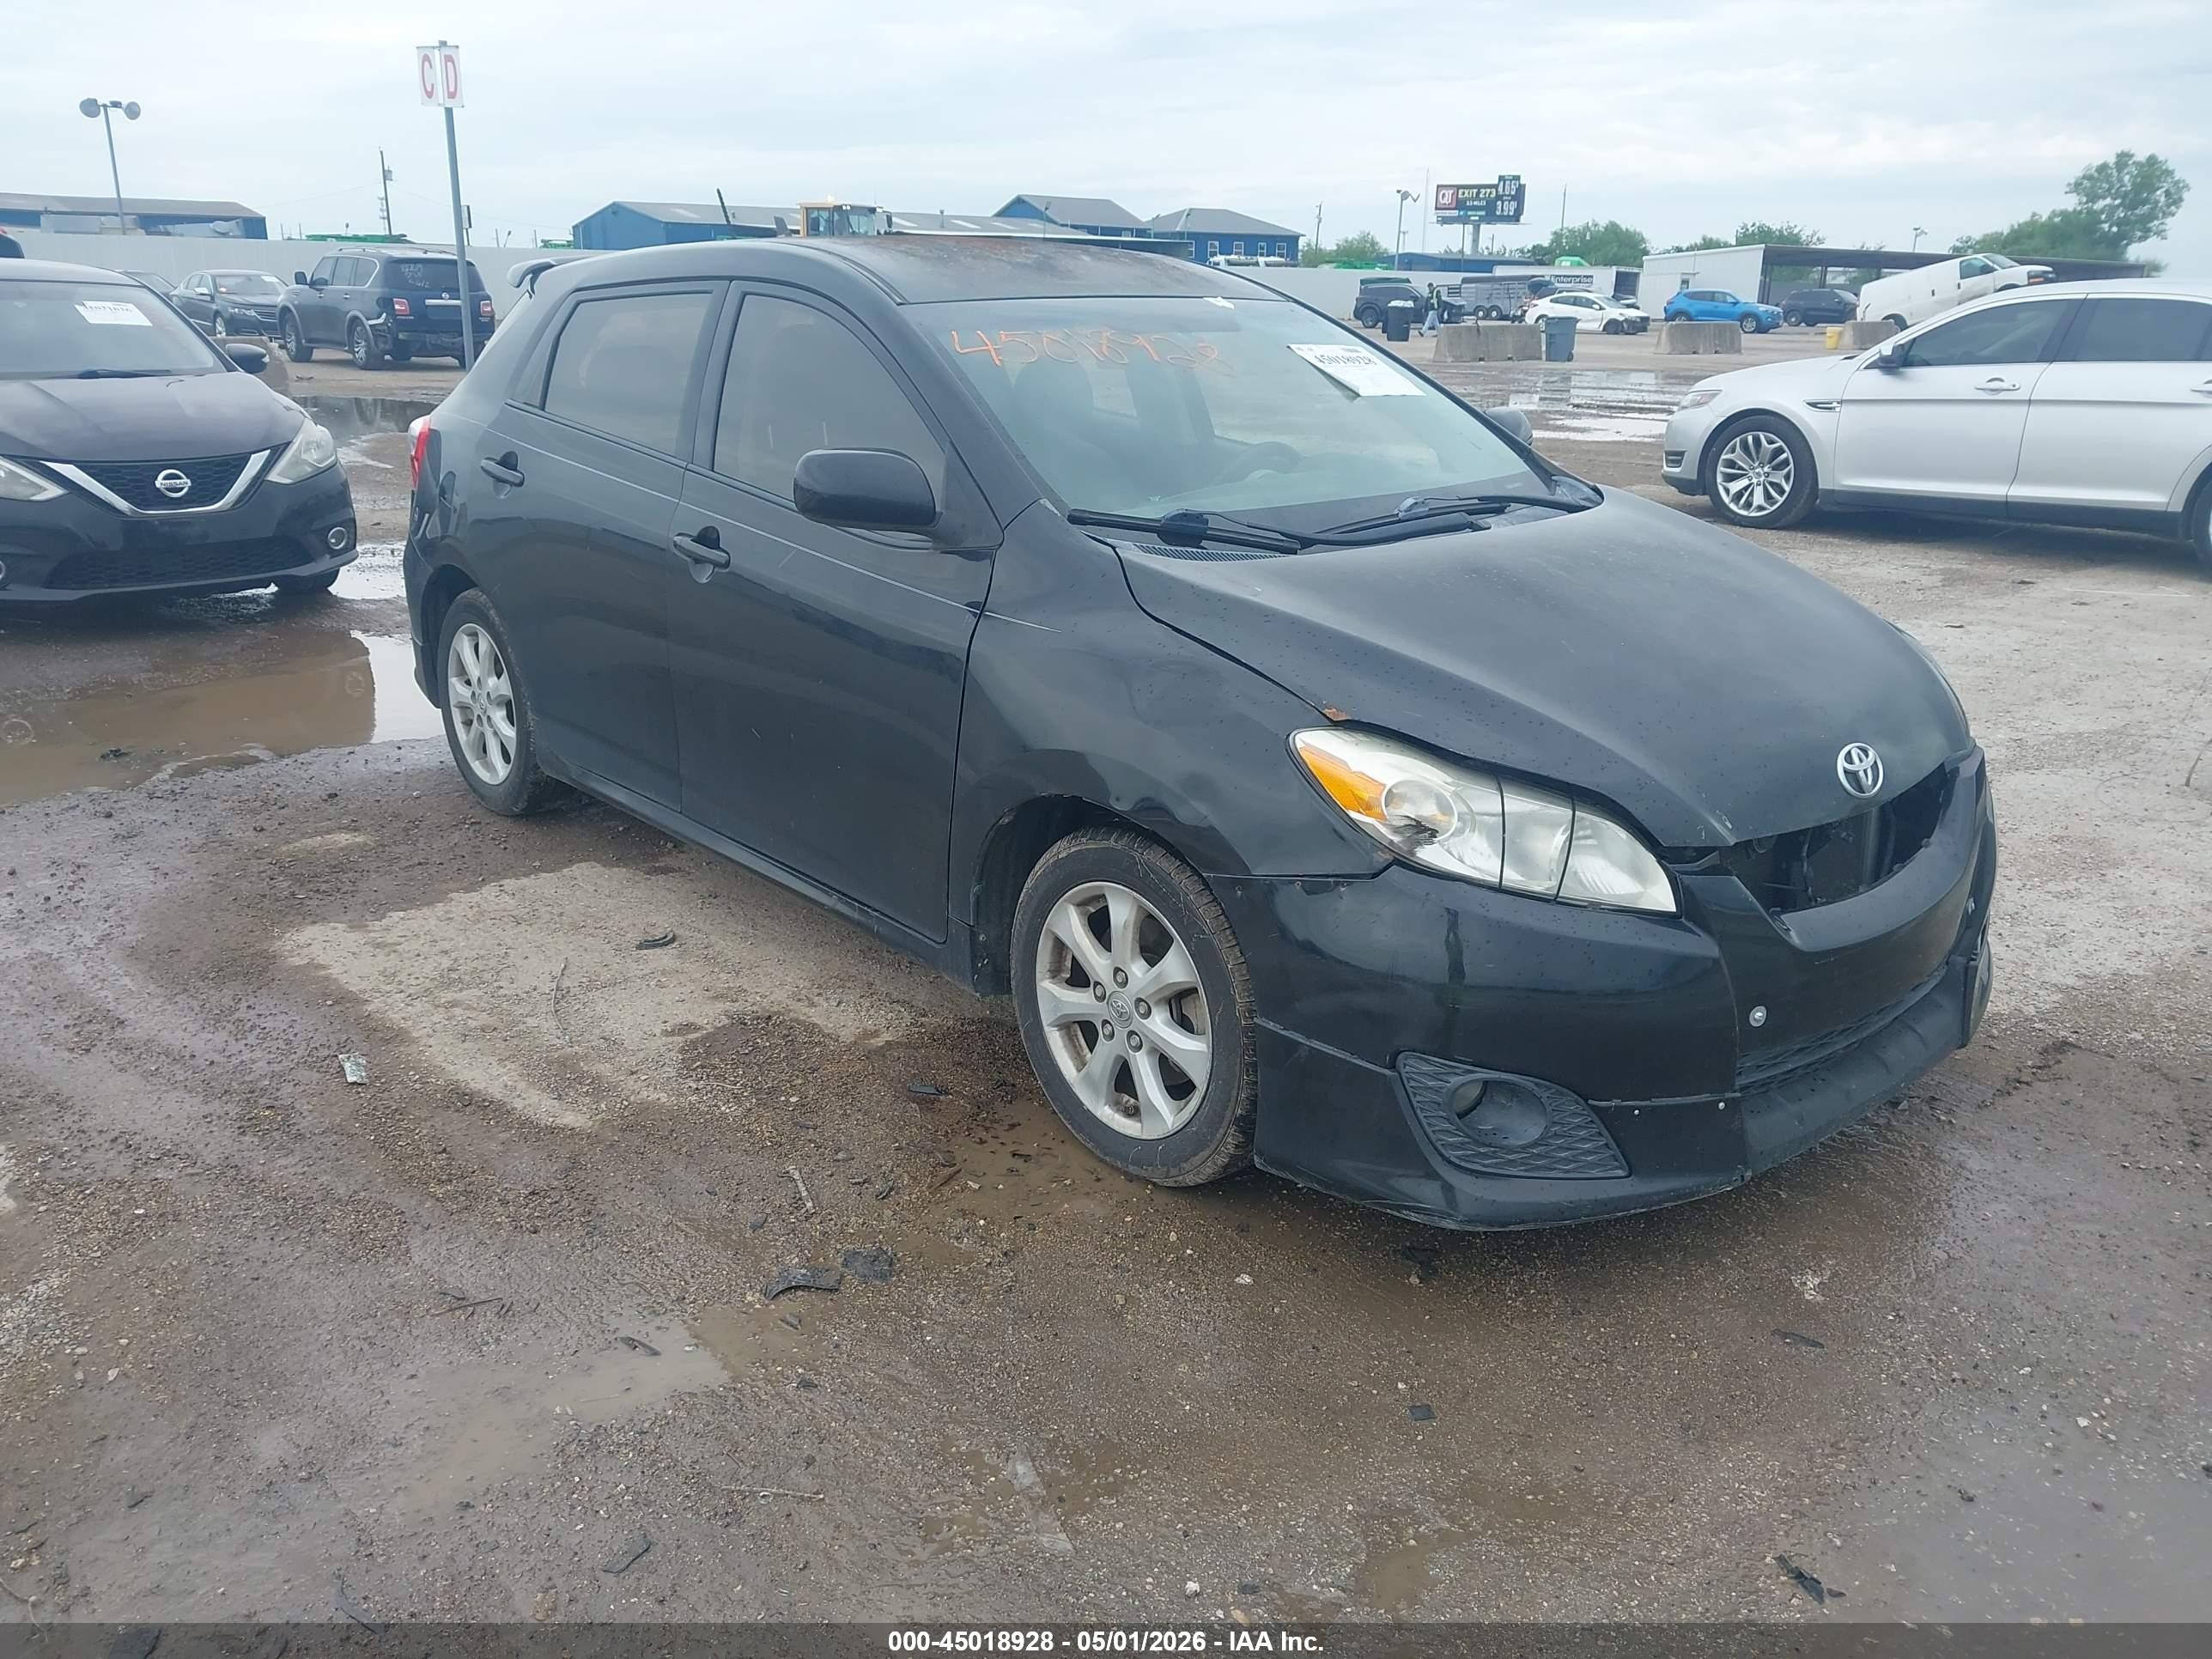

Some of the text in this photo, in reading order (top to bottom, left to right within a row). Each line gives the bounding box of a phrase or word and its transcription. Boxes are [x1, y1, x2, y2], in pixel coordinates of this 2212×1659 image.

[421, 53, 434, 100] C
[443, 54, 458, 100] D
[1439, 189, 1454, 204] QT
[1458, 188, 1478, 198] EXIT
[1479, 188, 1496, 198] 273
[1551, 275, 1593, 284] Enterprise
[160, 479, 188, 488] NISSAN
